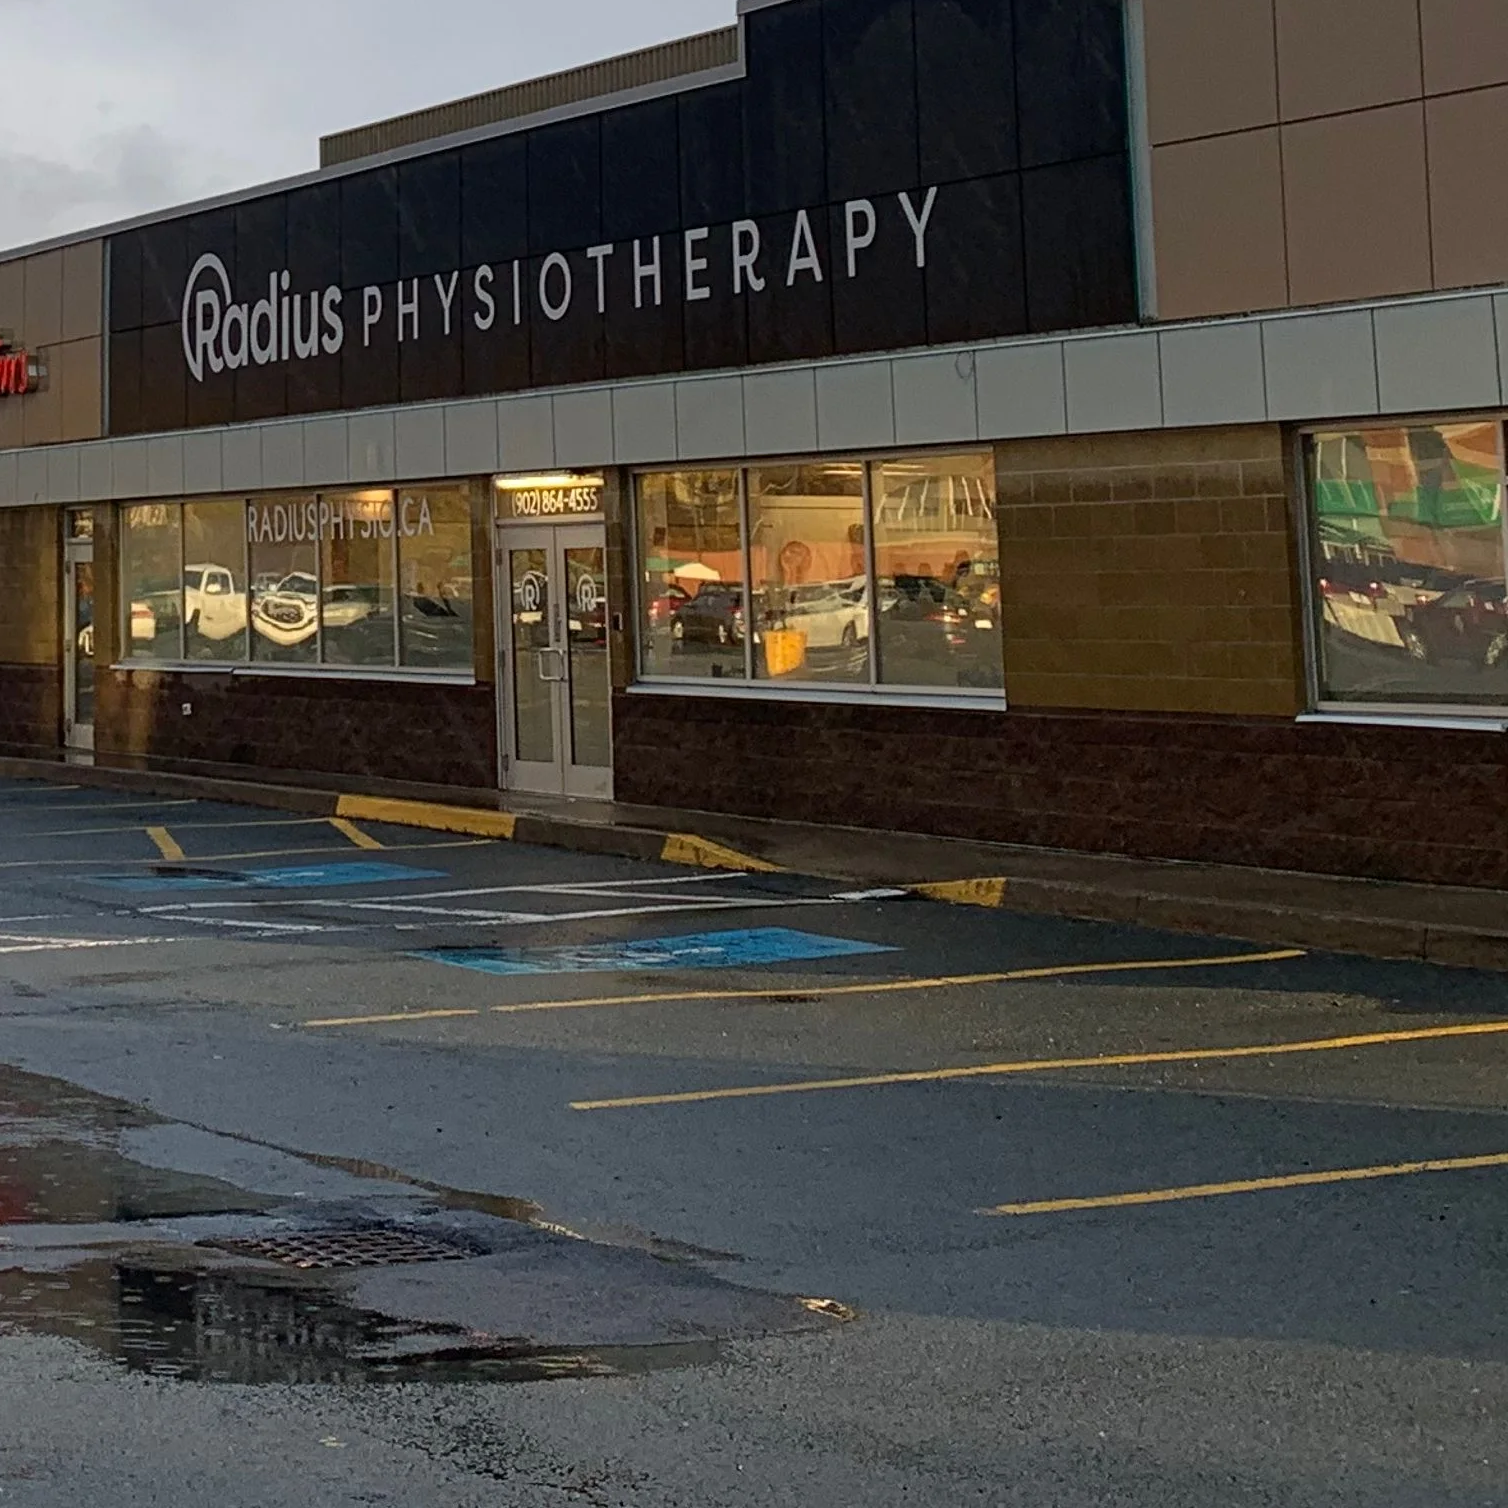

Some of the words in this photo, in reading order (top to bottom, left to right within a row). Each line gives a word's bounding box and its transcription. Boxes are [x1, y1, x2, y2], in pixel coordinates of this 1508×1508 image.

[182, 252, 344, 382] Radius
[363, 186, 938, 347] PHYSIOTHERAPY
[512, 490, 540, 517] (902)
[542, 487, 598, 513] 864-4555
